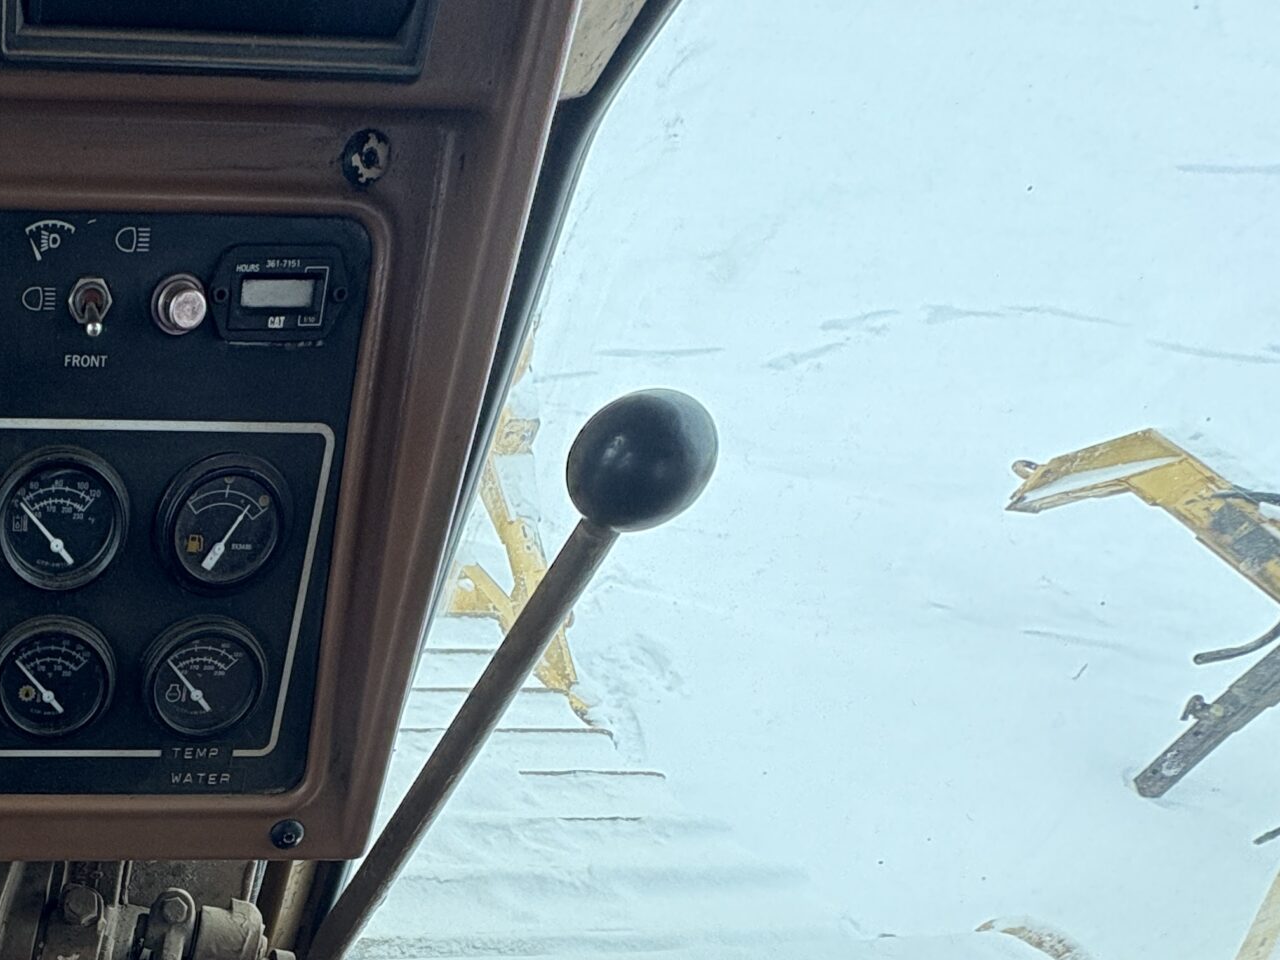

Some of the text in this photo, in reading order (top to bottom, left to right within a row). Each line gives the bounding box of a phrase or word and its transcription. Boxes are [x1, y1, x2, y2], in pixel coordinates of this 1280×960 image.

[235, 264, 260, 273] HOURS
[267, 316, 286, 329] CAT
[64, 355, 108, 368] FRONT
[172, 747, 219, 759] TEMP
[171, 773, 231, 784] WATER
